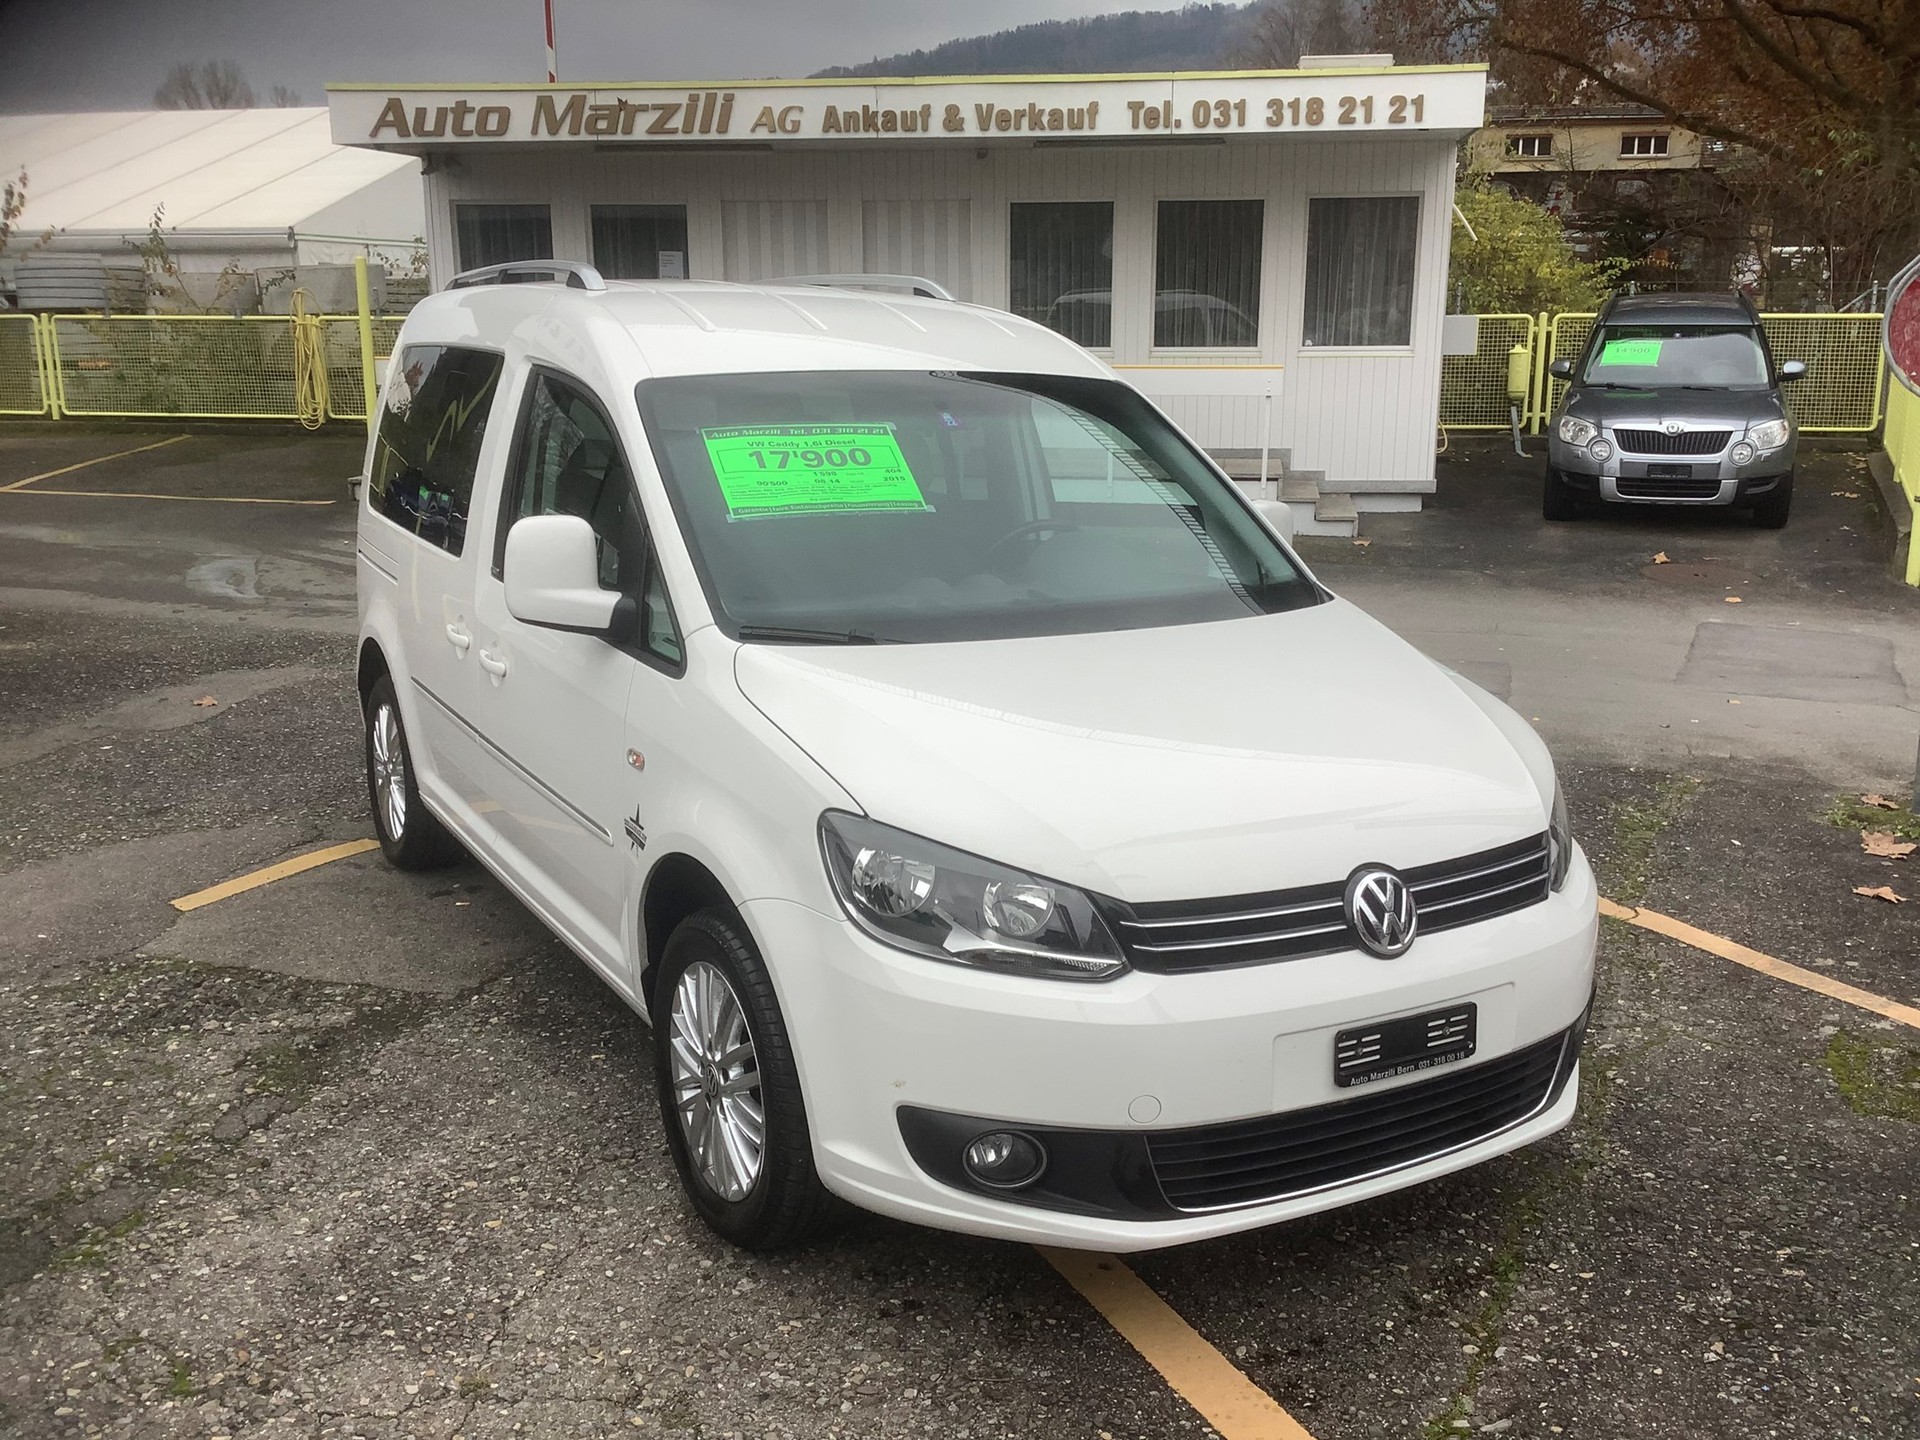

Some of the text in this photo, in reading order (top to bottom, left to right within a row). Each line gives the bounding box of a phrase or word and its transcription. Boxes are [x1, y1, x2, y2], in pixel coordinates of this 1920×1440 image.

[369, 92, 1425, 138] Auto Marzili AG Ankauf & Verkauf Tel. 031 318 21 21
[710, 430, 739, 438] Auto
[812, 427, 831, 435] 031
[768, 440, 800, 449] Caddy
[825, 438, 857, 446] Diesel
[748, 447, 872, 470] 17'900
[1350, 1076, 1368, 1086] Auto
[1370, 1069, 1396, 1081] Marzili
[1397, 1065, 1415, 1075] Bern
